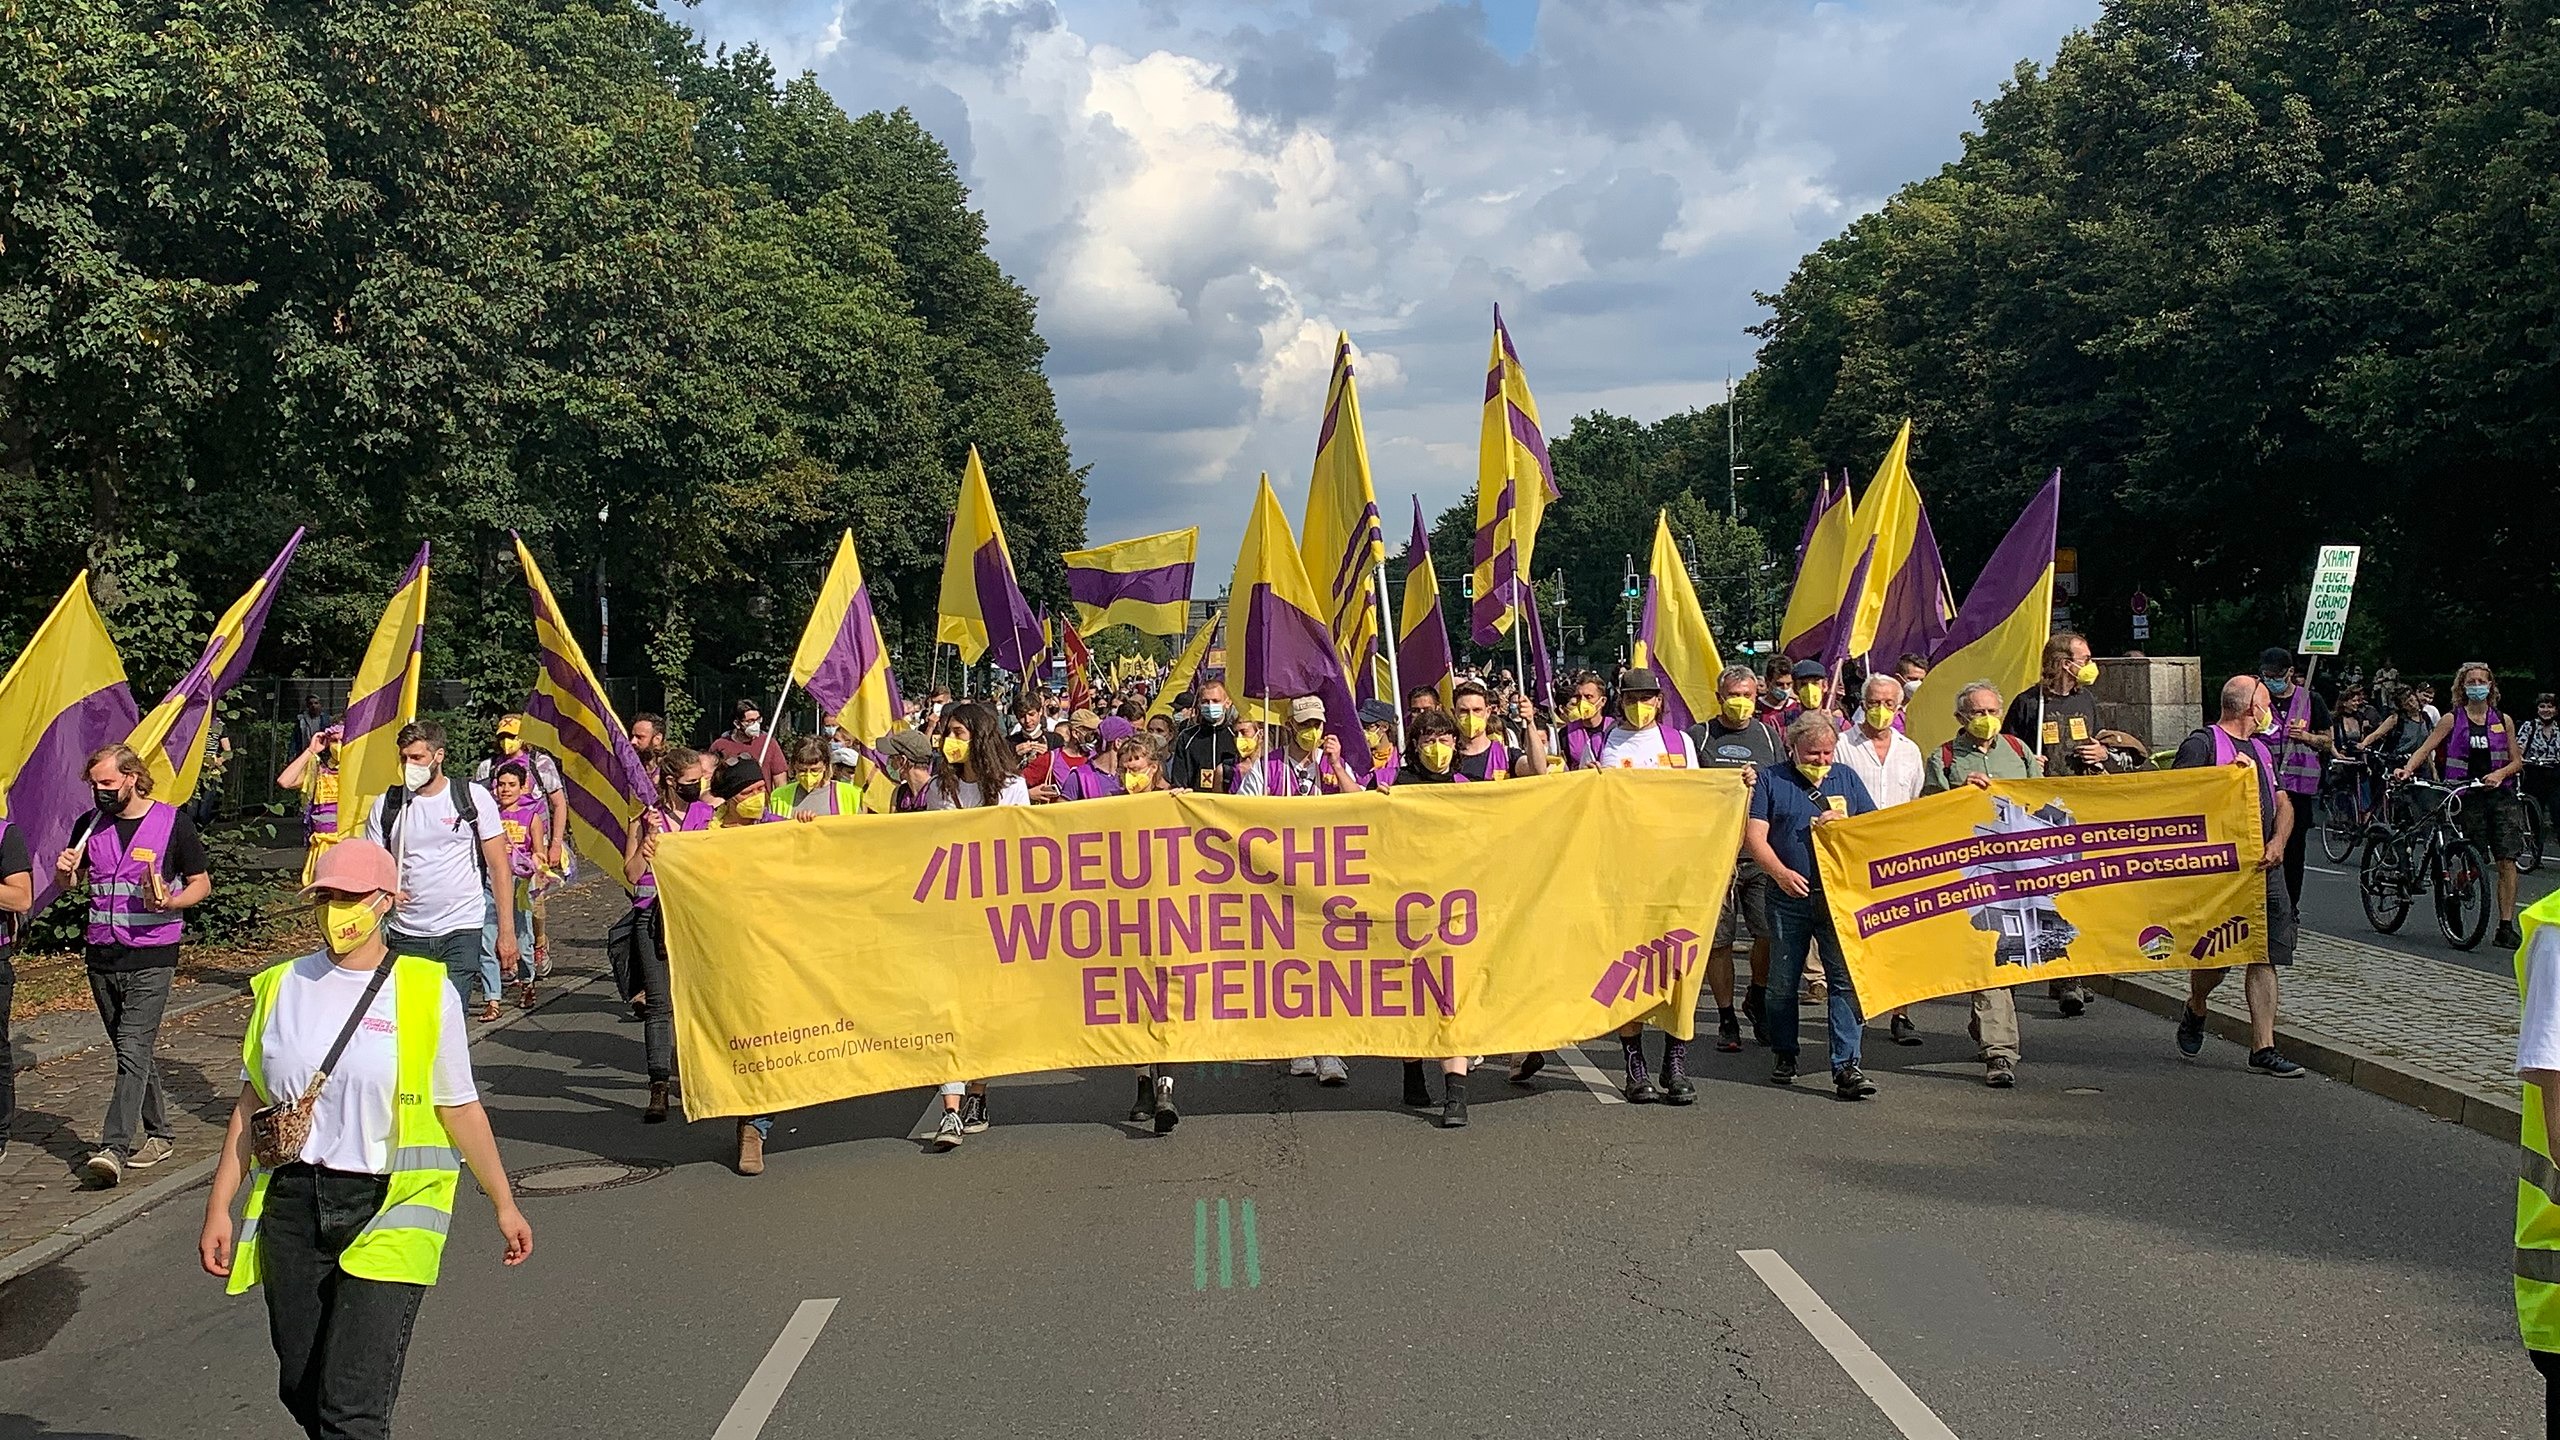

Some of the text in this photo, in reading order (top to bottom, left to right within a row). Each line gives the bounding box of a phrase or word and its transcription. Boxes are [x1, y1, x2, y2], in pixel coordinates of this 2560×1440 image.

[2315, 584, 2324, 593] IN
[2322, 572, 2348, 583] EUCH
[2314, 594, 2347, 609] GRUND
[2316, 610, 2336, 620] UND
[2306, 621, 2344, 640] BODEN
[1020, 825, 1370, 895] DEUTSCHE
[1876, 822, 2198, 879] Wohnungskonzerne enteignen:
[1862, 904, 1910, 931] Heute
[1914, 897, 1933, 915] in
[1936, 882, 1996, 908] Berlin
[2015, 867, 2096, 892] morgen
[2100, 861, 2121, 879] in
[2126, 850, 2230, 875] Potsdam!
[338, 922, 357, 939] Ja!
[985, 889, 1479, 964] WOHNEN & CO
[1082, 956, 1456, 1026] ENTEIGNEN
[729, 1018, 855, 1051] dwenteignen.de
[732, 1031, 954, 1075] facebook.com/DWenteignen
